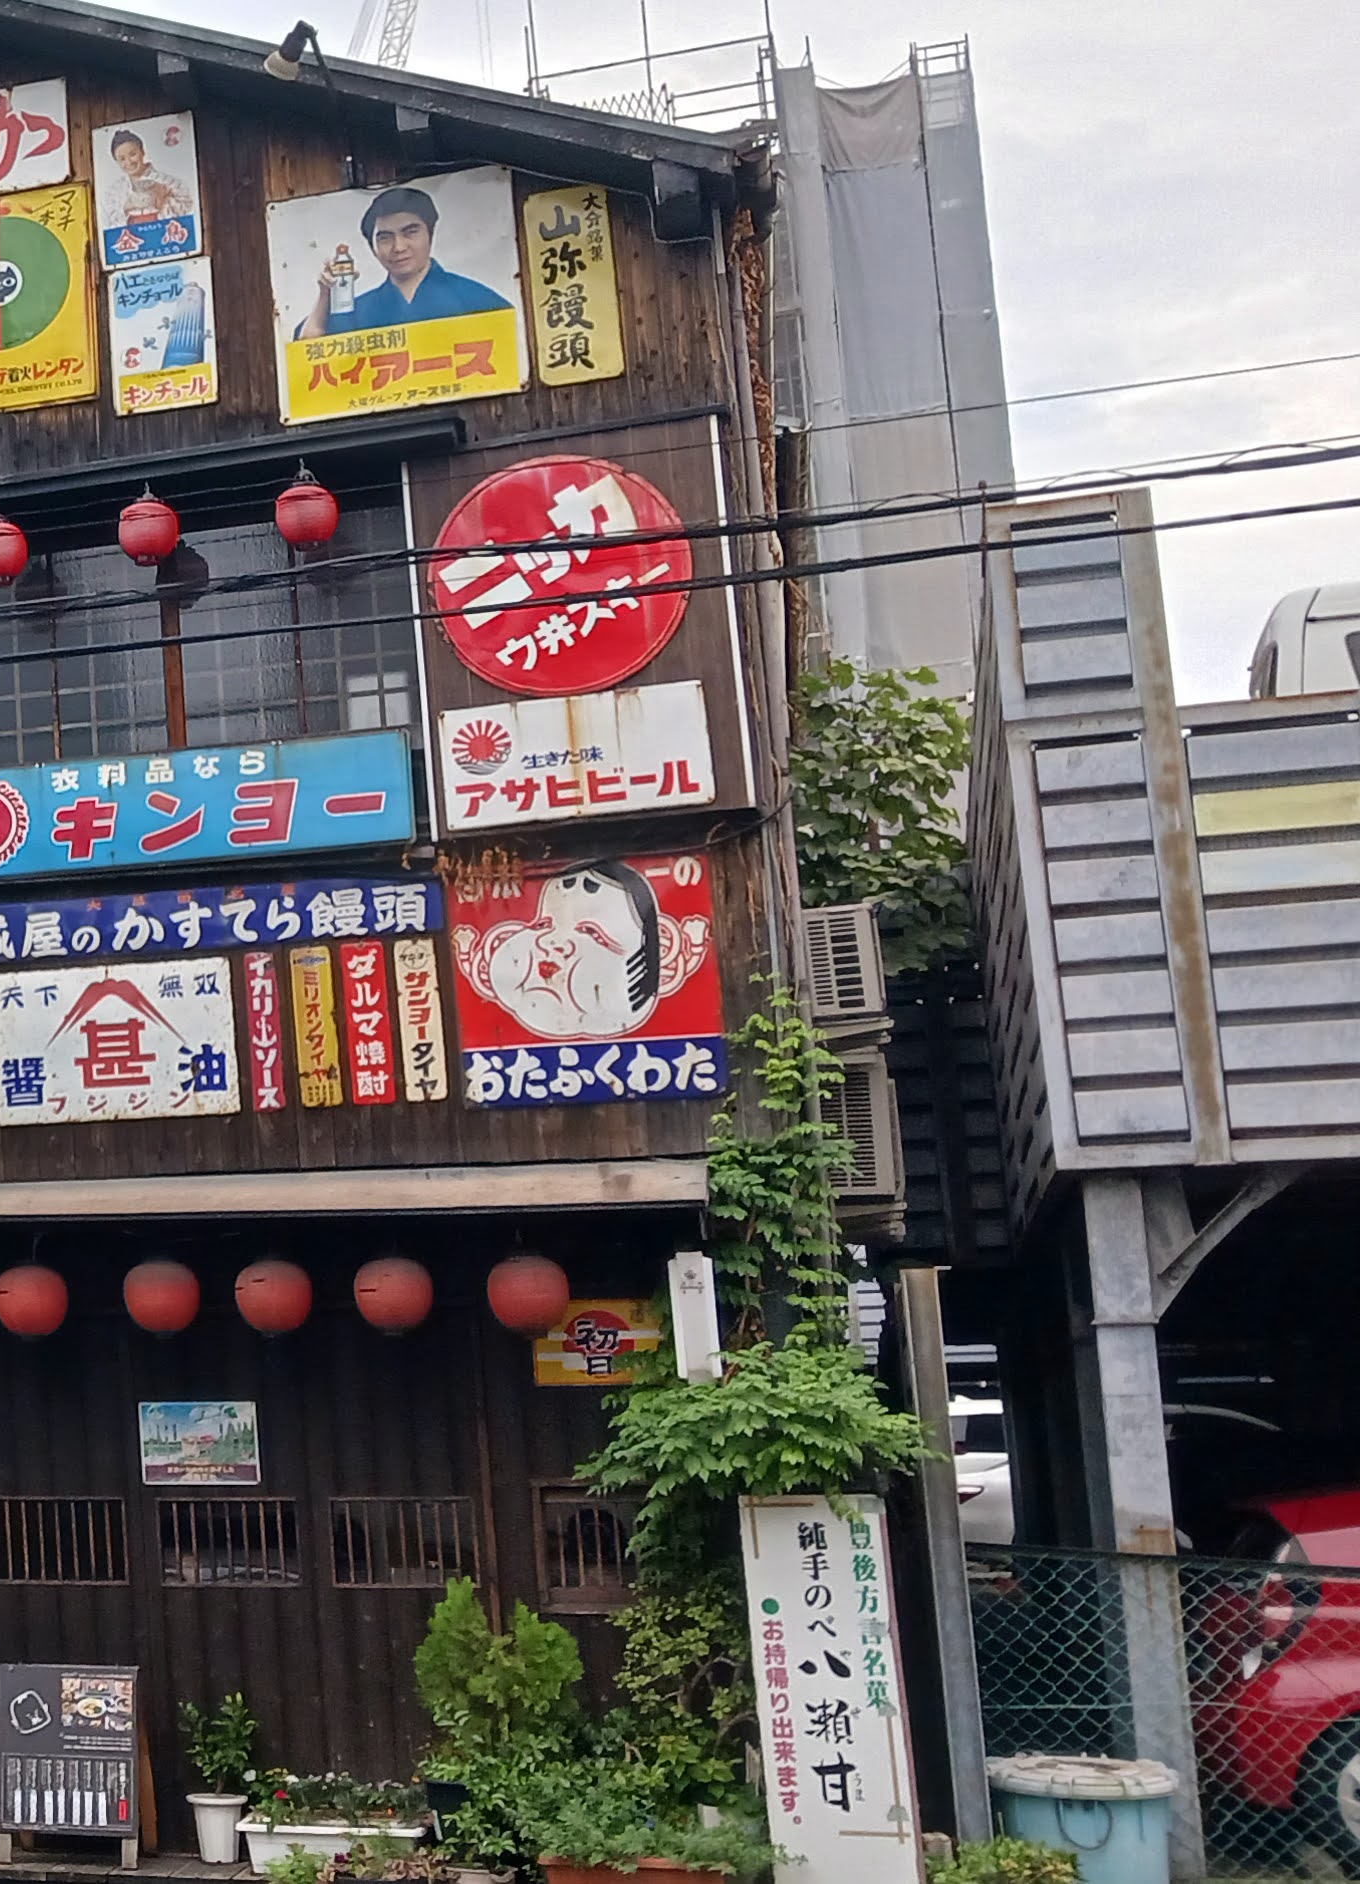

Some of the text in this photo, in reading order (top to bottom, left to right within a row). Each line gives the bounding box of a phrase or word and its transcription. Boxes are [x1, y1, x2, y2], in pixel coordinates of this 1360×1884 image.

[114, 220, 187, 252] 金鳥
[117, 283, 183, 308] キンチョール
[306, 328, 406, 361] 強力殺虫剤
[308, 339, 497, 392] ハイアース
[124, 376, 208, 406] キンチョール
[438, 473, 638, 630] ニッカ
[51, 749, 267, 792] 衣料品なら
[521, 745, 604, 770] 生きた味
[455, 759, 700, 818] アサヒビール
[52, 777, 386, 862] キンヨー
[0, 972, 222, 1010] 天下 無双
[303, 971, 328, 1083] ミリオンタイヤ
[347, 949, 389, 1097] ダルマ焼酎
[404, 971, 438, 1100] サンヨータイヤ
[74, 1017, 156, 1090] 甚
[179, 1044, 228, 1094] 油
[465, 1041, 716, 1103] おたふくわた
[762, 1618, 802, 1825] お持帰り出来ます。
